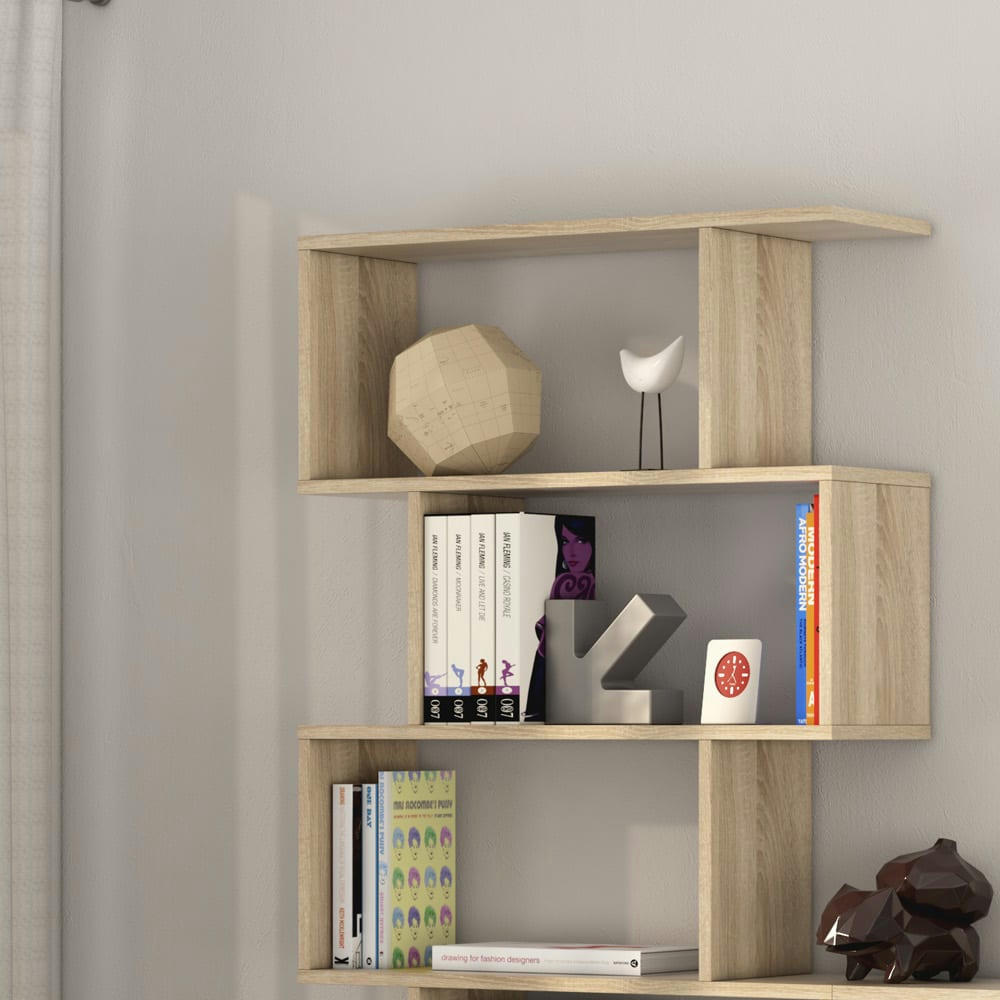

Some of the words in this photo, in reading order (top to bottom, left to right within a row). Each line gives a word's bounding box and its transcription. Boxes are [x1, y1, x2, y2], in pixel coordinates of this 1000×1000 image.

[503, 532, 511, 542] IAN
[503, 543, 511, 568] FLEMING
[798, 555, 806, 611] MODERN
[430, 699, 440, 719] 007
[454, 699, 464, 719] 007
[477, 698, 488, 718] 007
[500, 698, 514, 718] 007
[442, 954, 468, 963] drawing
[480, 954, 506, 963] fashion
[506, 956, 540, 965] designers
